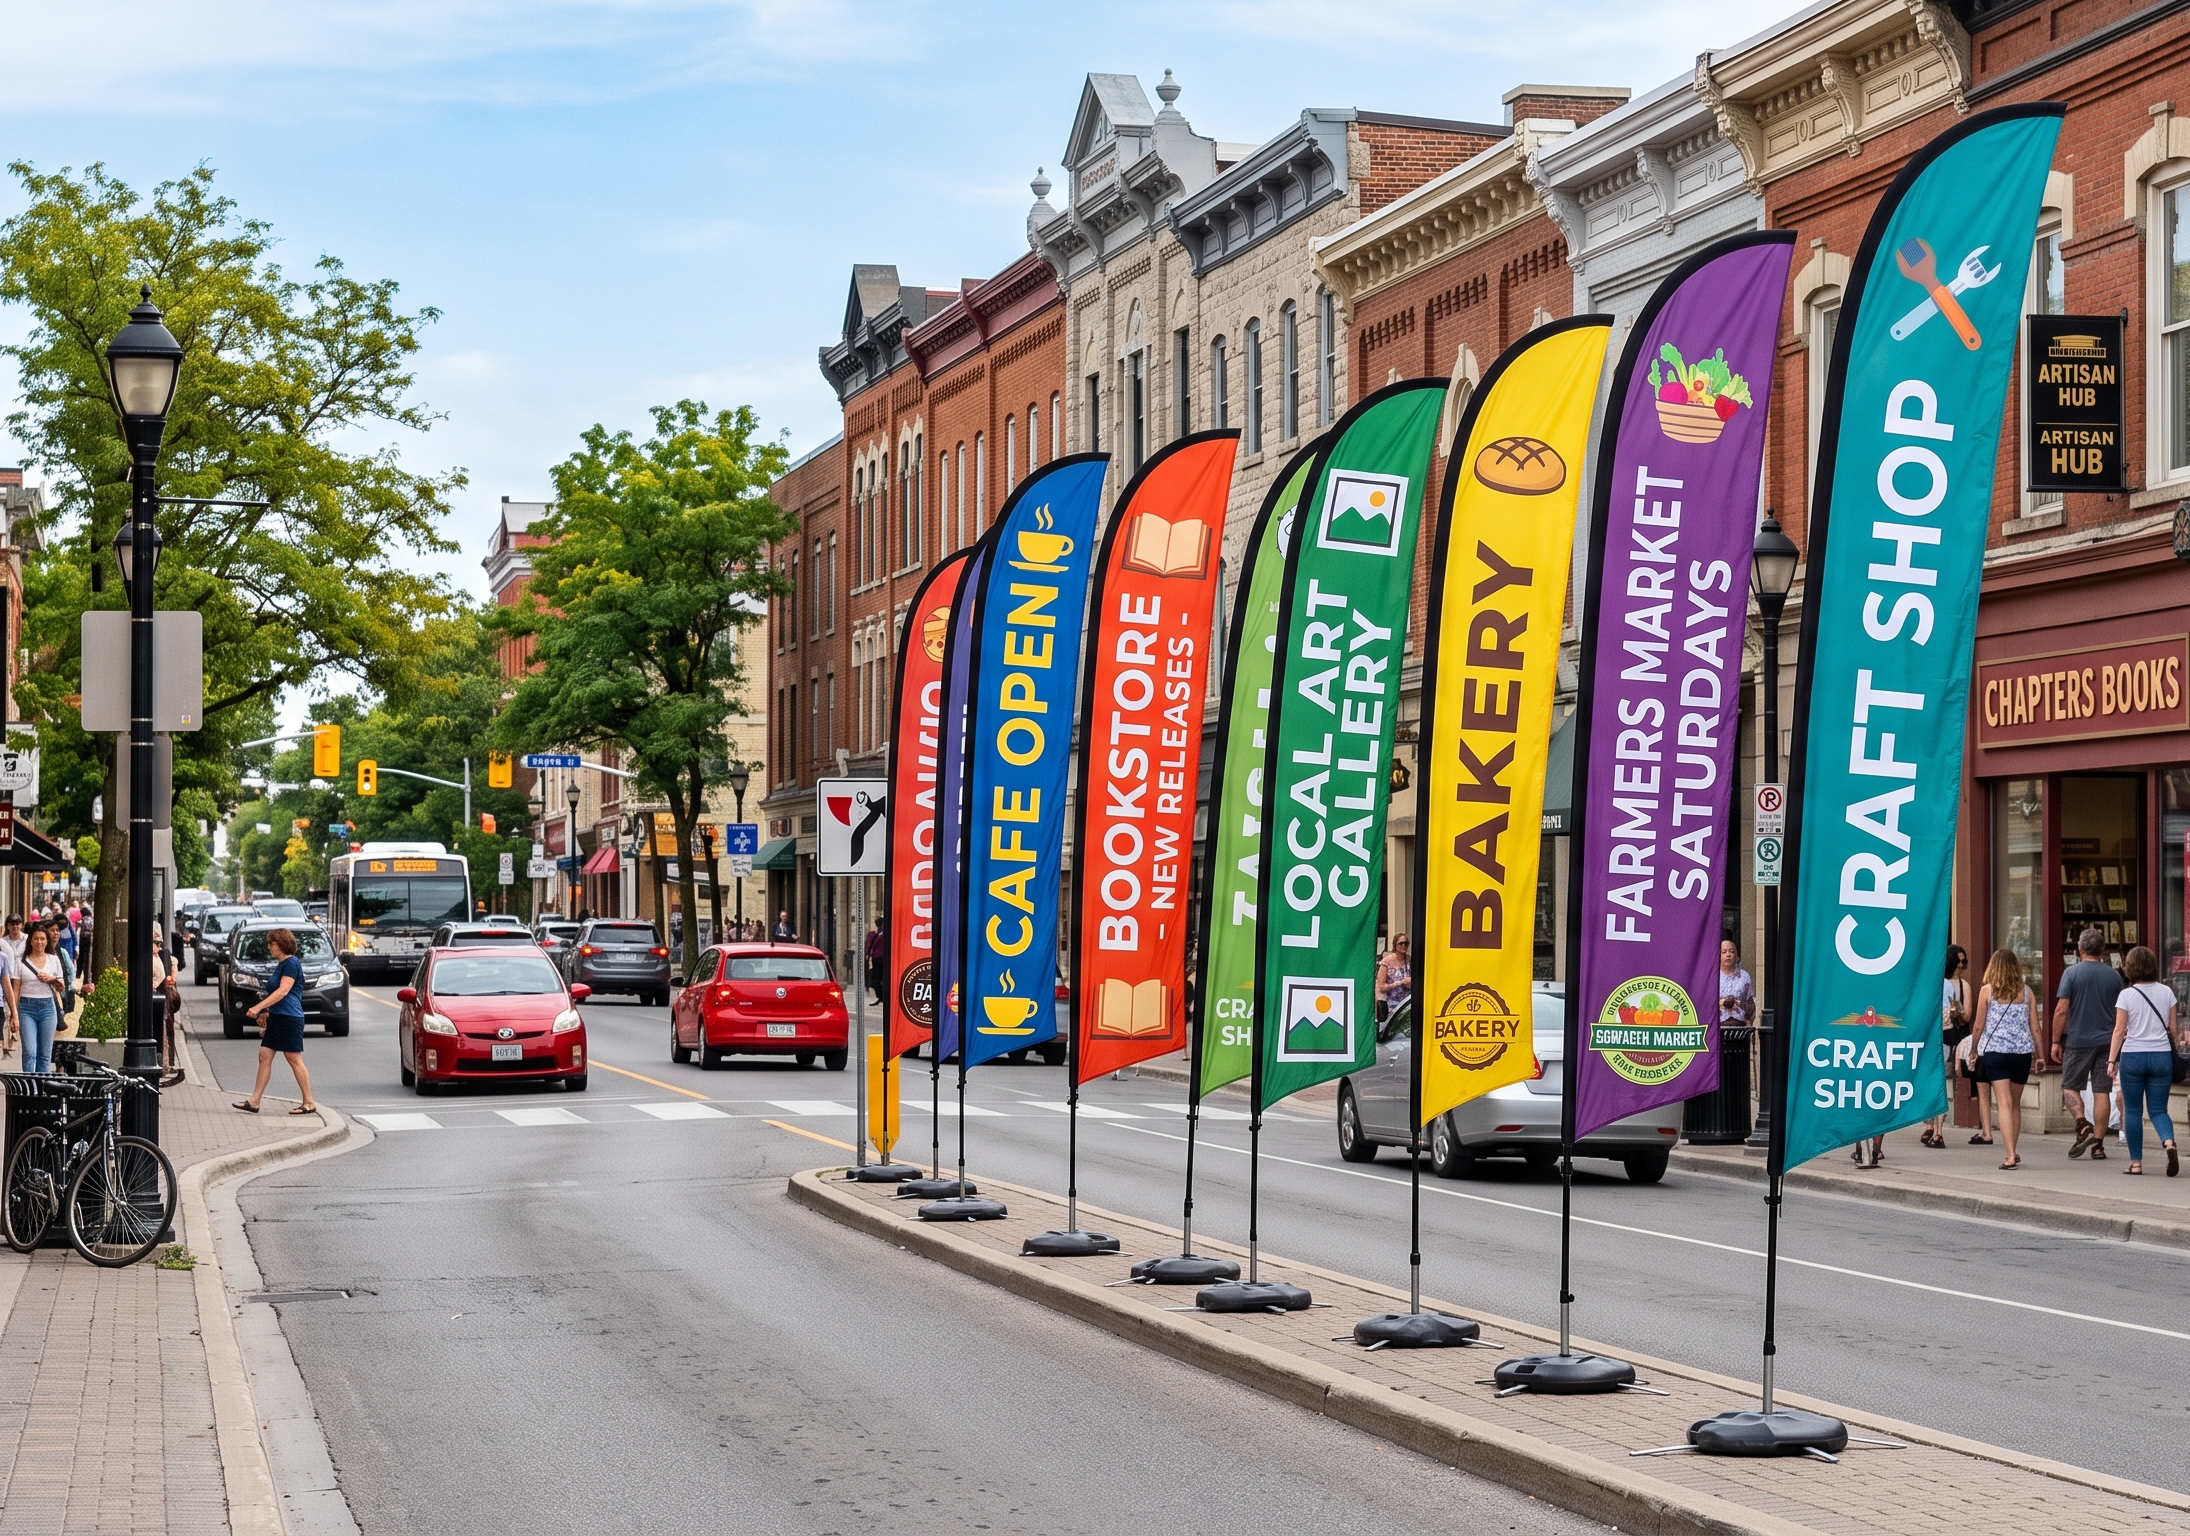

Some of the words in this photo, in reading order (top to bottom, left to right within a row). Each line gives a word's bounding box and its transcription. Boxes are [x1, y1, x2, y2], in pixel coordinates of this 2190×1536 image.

[2038, 363, 2115, 385] ARTISAN
[2039, 430, 2114, 446] ARTISAN
[2058, 387, 2097, 407] HUB
[1862, 379, 1955, 646] SHOP
[2051, 448, 2104, 475] HUB
[1298, 578, 1348, 715] ART
[1620, 465, 1684, 683] MARKET
[996, 583, 1058, 765] OPEN
[1156, 637, 1194, 814] RELEASES
[1328, 608, 1392, 908] GALLERY
[1449, 539, 1534, 950] BAKERY
[1667, 559, 1732, 901] SATURDAYS
[1984, 667, 2095, 728] CHAPTERS
[2102, 656, 2180, 715] BOOKS
[1098, 593, 1162, 951] BOOKSTORE
[1281, 733, 1333, 949] LOCAL
[1605, 698, 1665, 943] FARMERS
[1835, 668, 1925, 975] CRAFT
[985, 787, 1040, 957] CAFE
[1150, 825, 1180, 909] NEW
[1434, 1019, 1520, 1040] BAKERY
[1653, 1031, 1703, 1047] MARKET
[1807, 1038, 1925, 1070] CRAFT
[1813, 1078, 1914, 1110] SHOP
